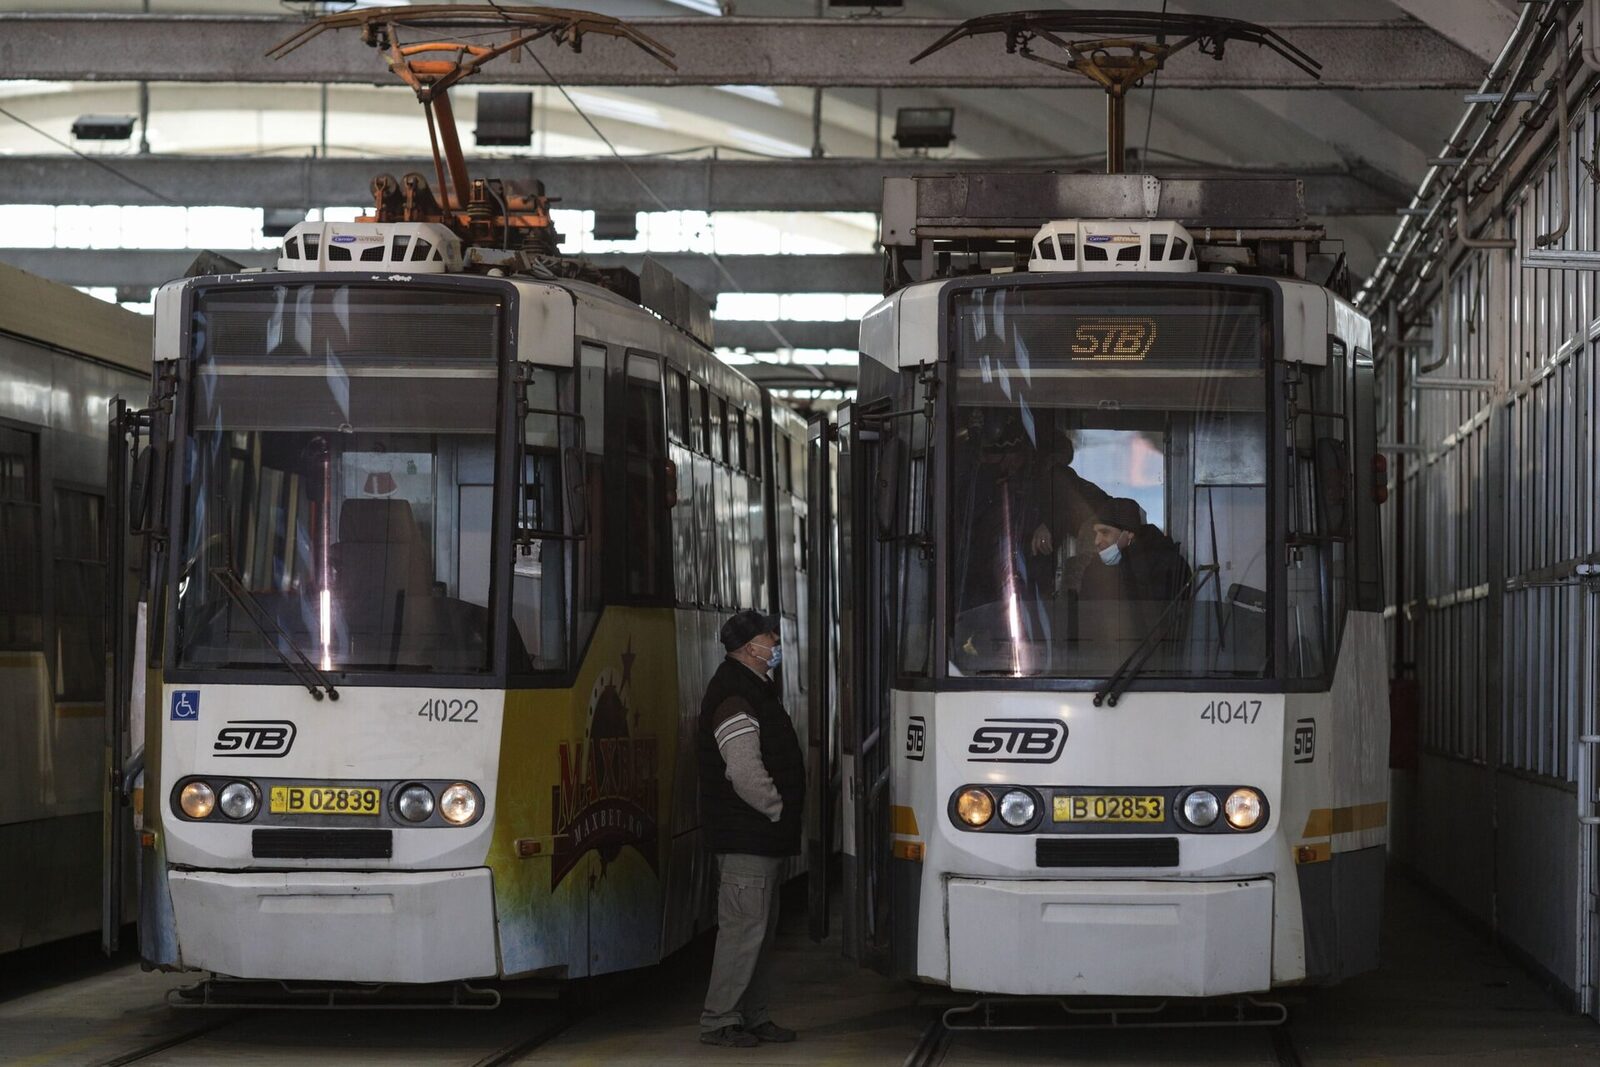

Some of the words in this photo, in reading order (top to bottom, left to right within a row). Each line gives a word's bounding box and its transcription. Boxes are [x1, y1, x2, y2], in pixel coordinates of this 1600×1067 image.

[1072, 324, 1146, 353] STB
[418, 698, 478, 723] 4022
[1201, 700, 1262, 724] 4047
[213, 727, 289, 751] STB
[906, 724, 924, 752] STB
[968, 726, 1059, 755] STB
[1294, 726, 1314, 756] STB
[289, 789, 304, 810] B
[310, 789, 376, 811] 02839
[1073, 798, 1088, 818] B
[1094, 797, 1161, 818] 02853
[574, 808, 643, 846] MAXBET.RO
